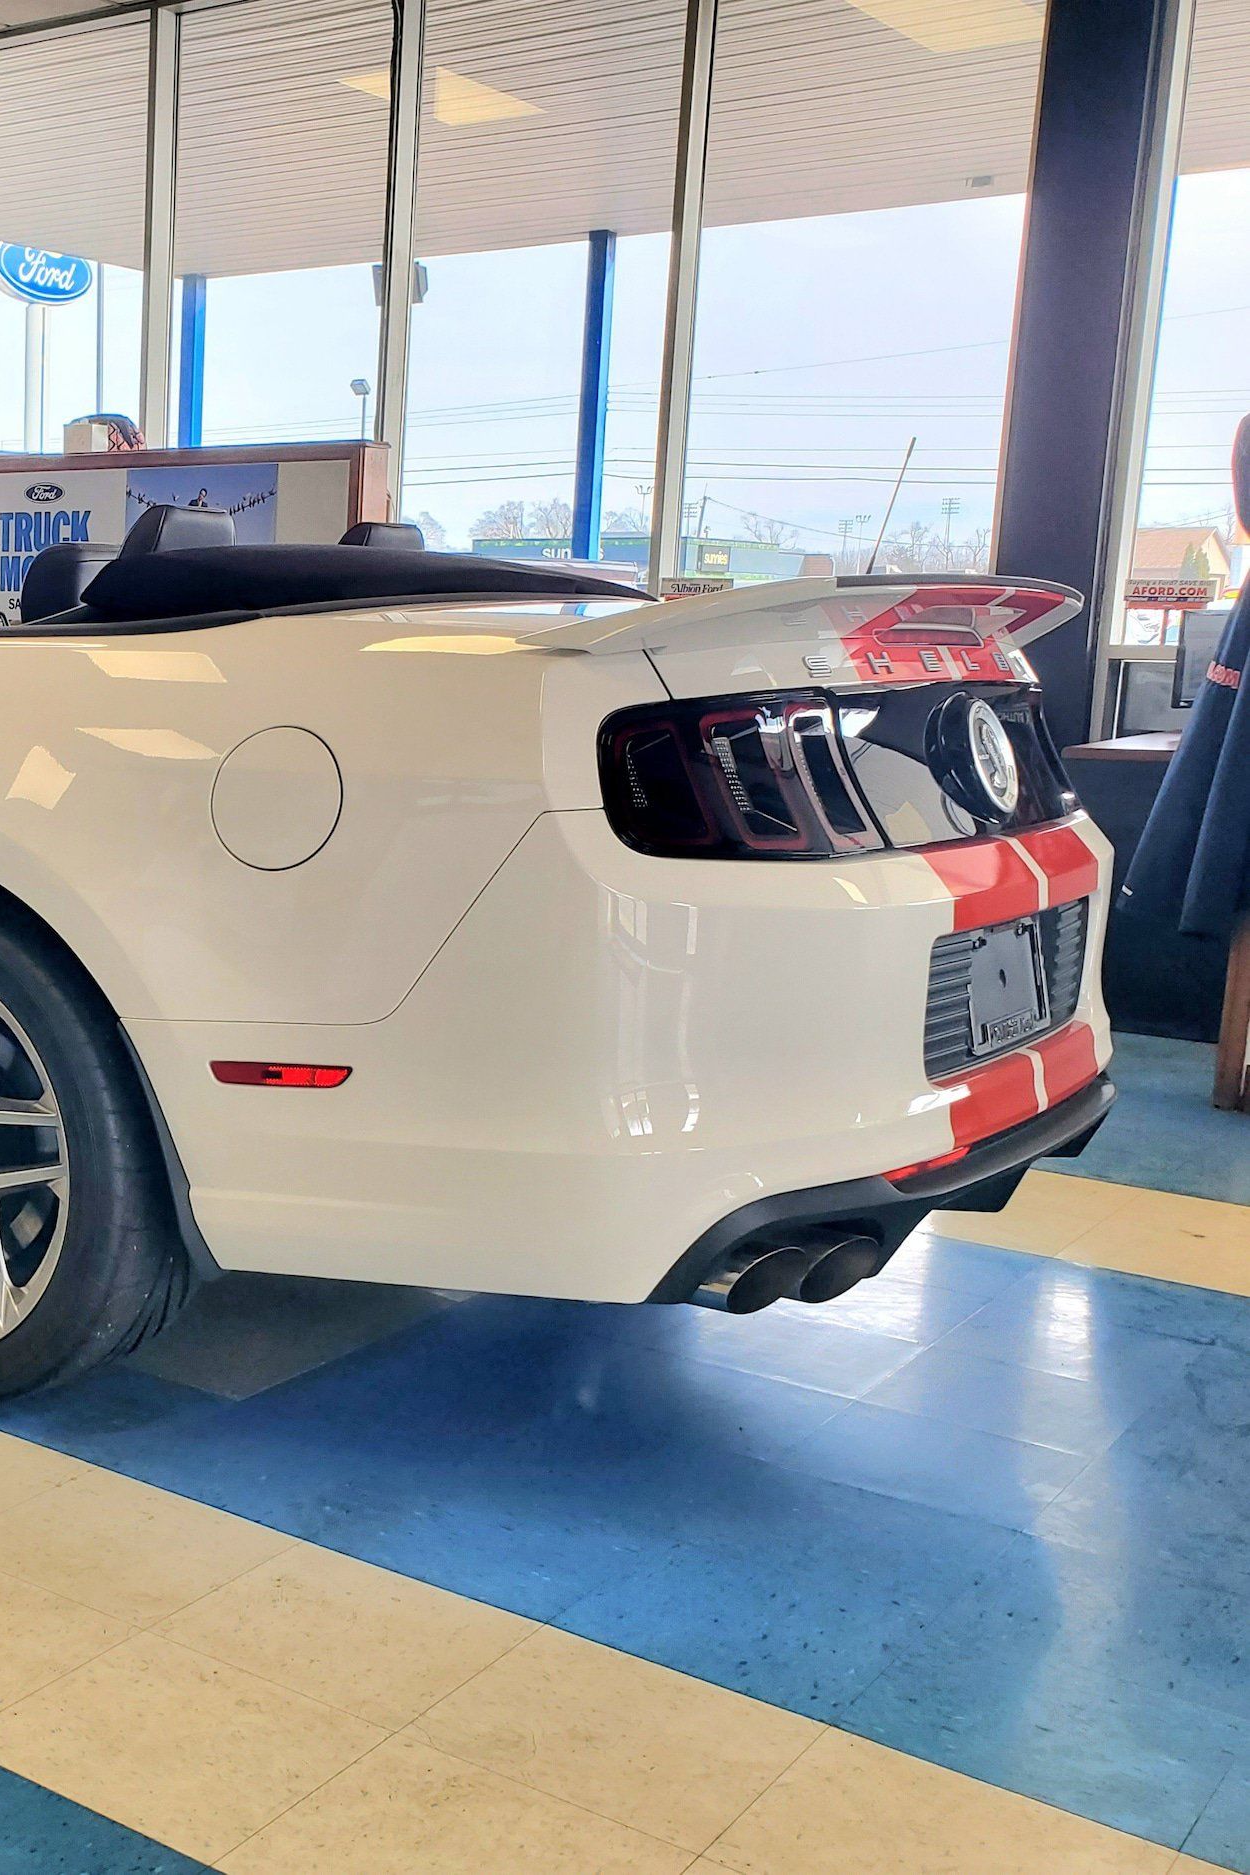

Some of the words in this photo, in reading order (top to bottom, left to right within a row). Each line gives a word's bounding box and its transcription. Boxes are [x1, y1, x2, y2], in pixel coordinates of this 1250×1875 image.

[18, 247, 76, 290] Ford
[31, 485, 57, 500] Ford
[0, 511, 91, 553] TRUCK
[1133, 586, 1207, 596] AFORD.COM
